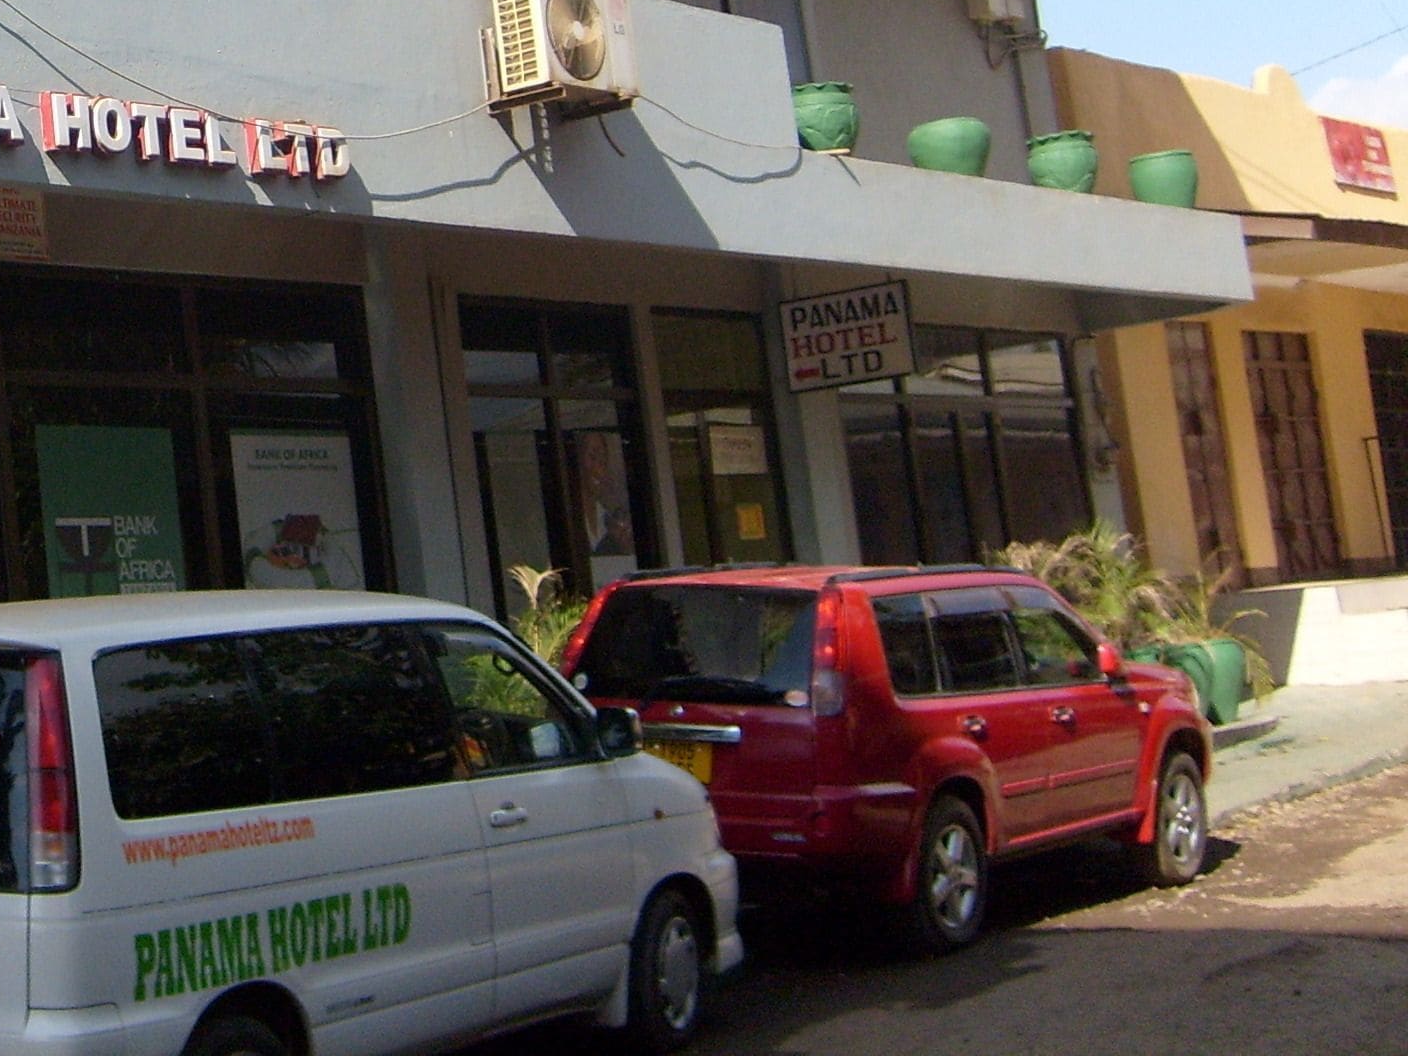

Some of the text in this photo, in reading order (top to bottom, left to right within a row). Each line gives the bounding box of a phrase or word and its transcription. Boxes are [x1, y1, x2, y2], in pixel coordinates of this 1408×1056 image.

[41, 90, 237, 165] HOTEL
[244, 118, 351, 180] LTD
[790, 291, 900, 332] PANAMA
[791, 322, 898, 359] HOTEL
[820, 349, 883, 379] LTD
[113, 515, 159, 536] BANK
[115, 537, 137, 558] OF
[118, 559, 176, 581] AFRICA
[134, 884, 411, 1003] PANAMA HOTEL LTD
